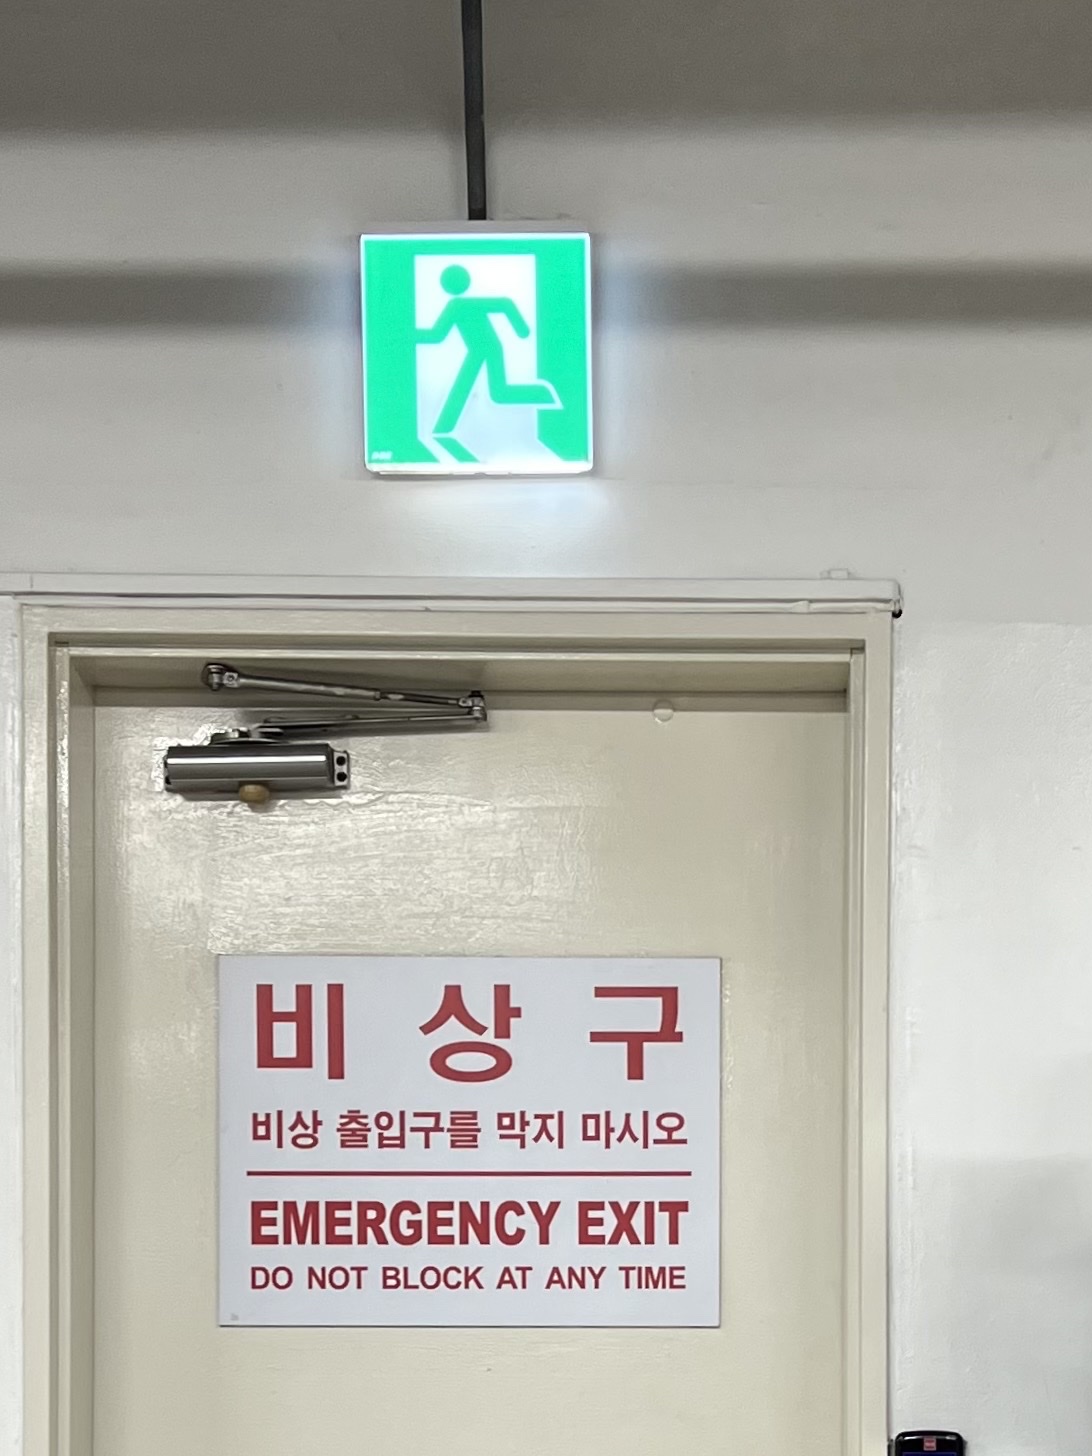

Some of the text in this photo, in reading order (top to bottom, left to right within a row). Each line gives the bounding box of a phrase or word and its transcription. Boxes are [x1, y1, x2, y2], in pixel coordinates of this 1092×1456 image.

[251, 1109, 688, 1150] 비상 출입구를 막지 마시오
[250, 1200, 689, 1246] EMERGENCY EXIT
[250, 1265, 687, 1290] DO NOT BLOCK AT ANY TIME
